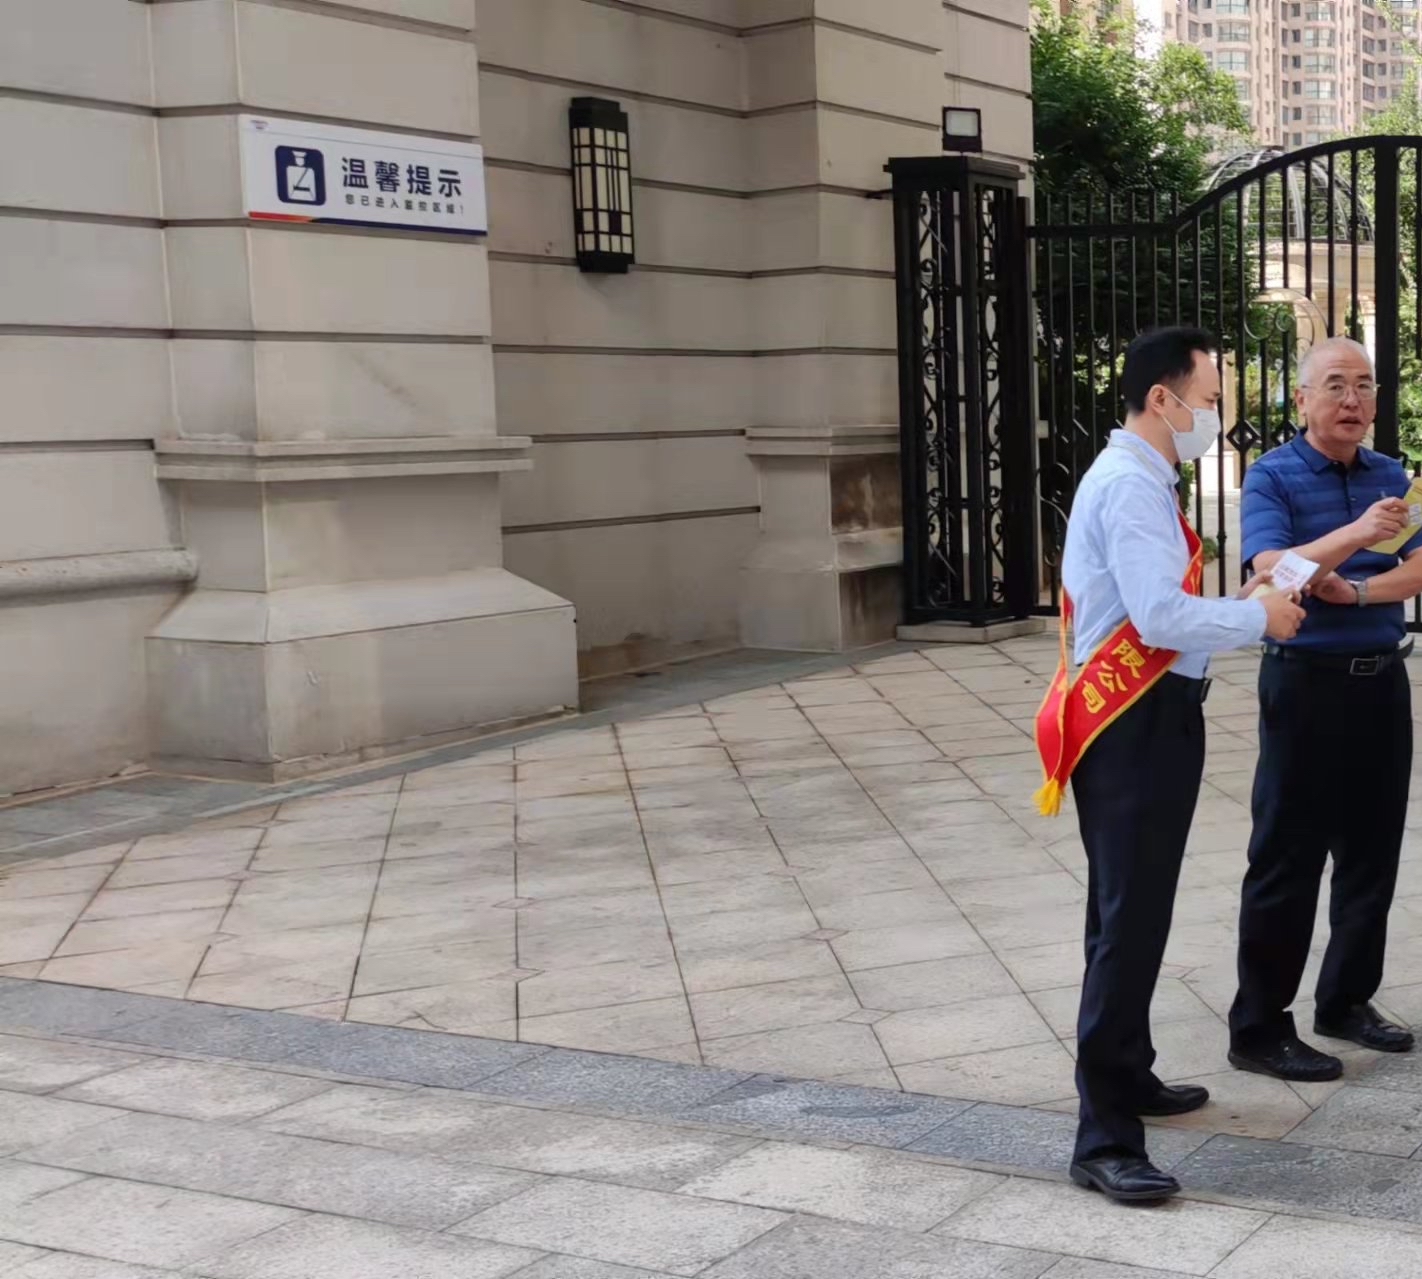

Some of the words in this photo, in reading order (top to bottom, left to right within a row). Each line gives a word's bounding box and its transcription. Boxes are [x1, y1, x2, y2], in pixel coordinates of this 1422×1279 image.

[341, 156, 462, 198] 温馨提示
[1081, 638, 1154, 714] 限公司
